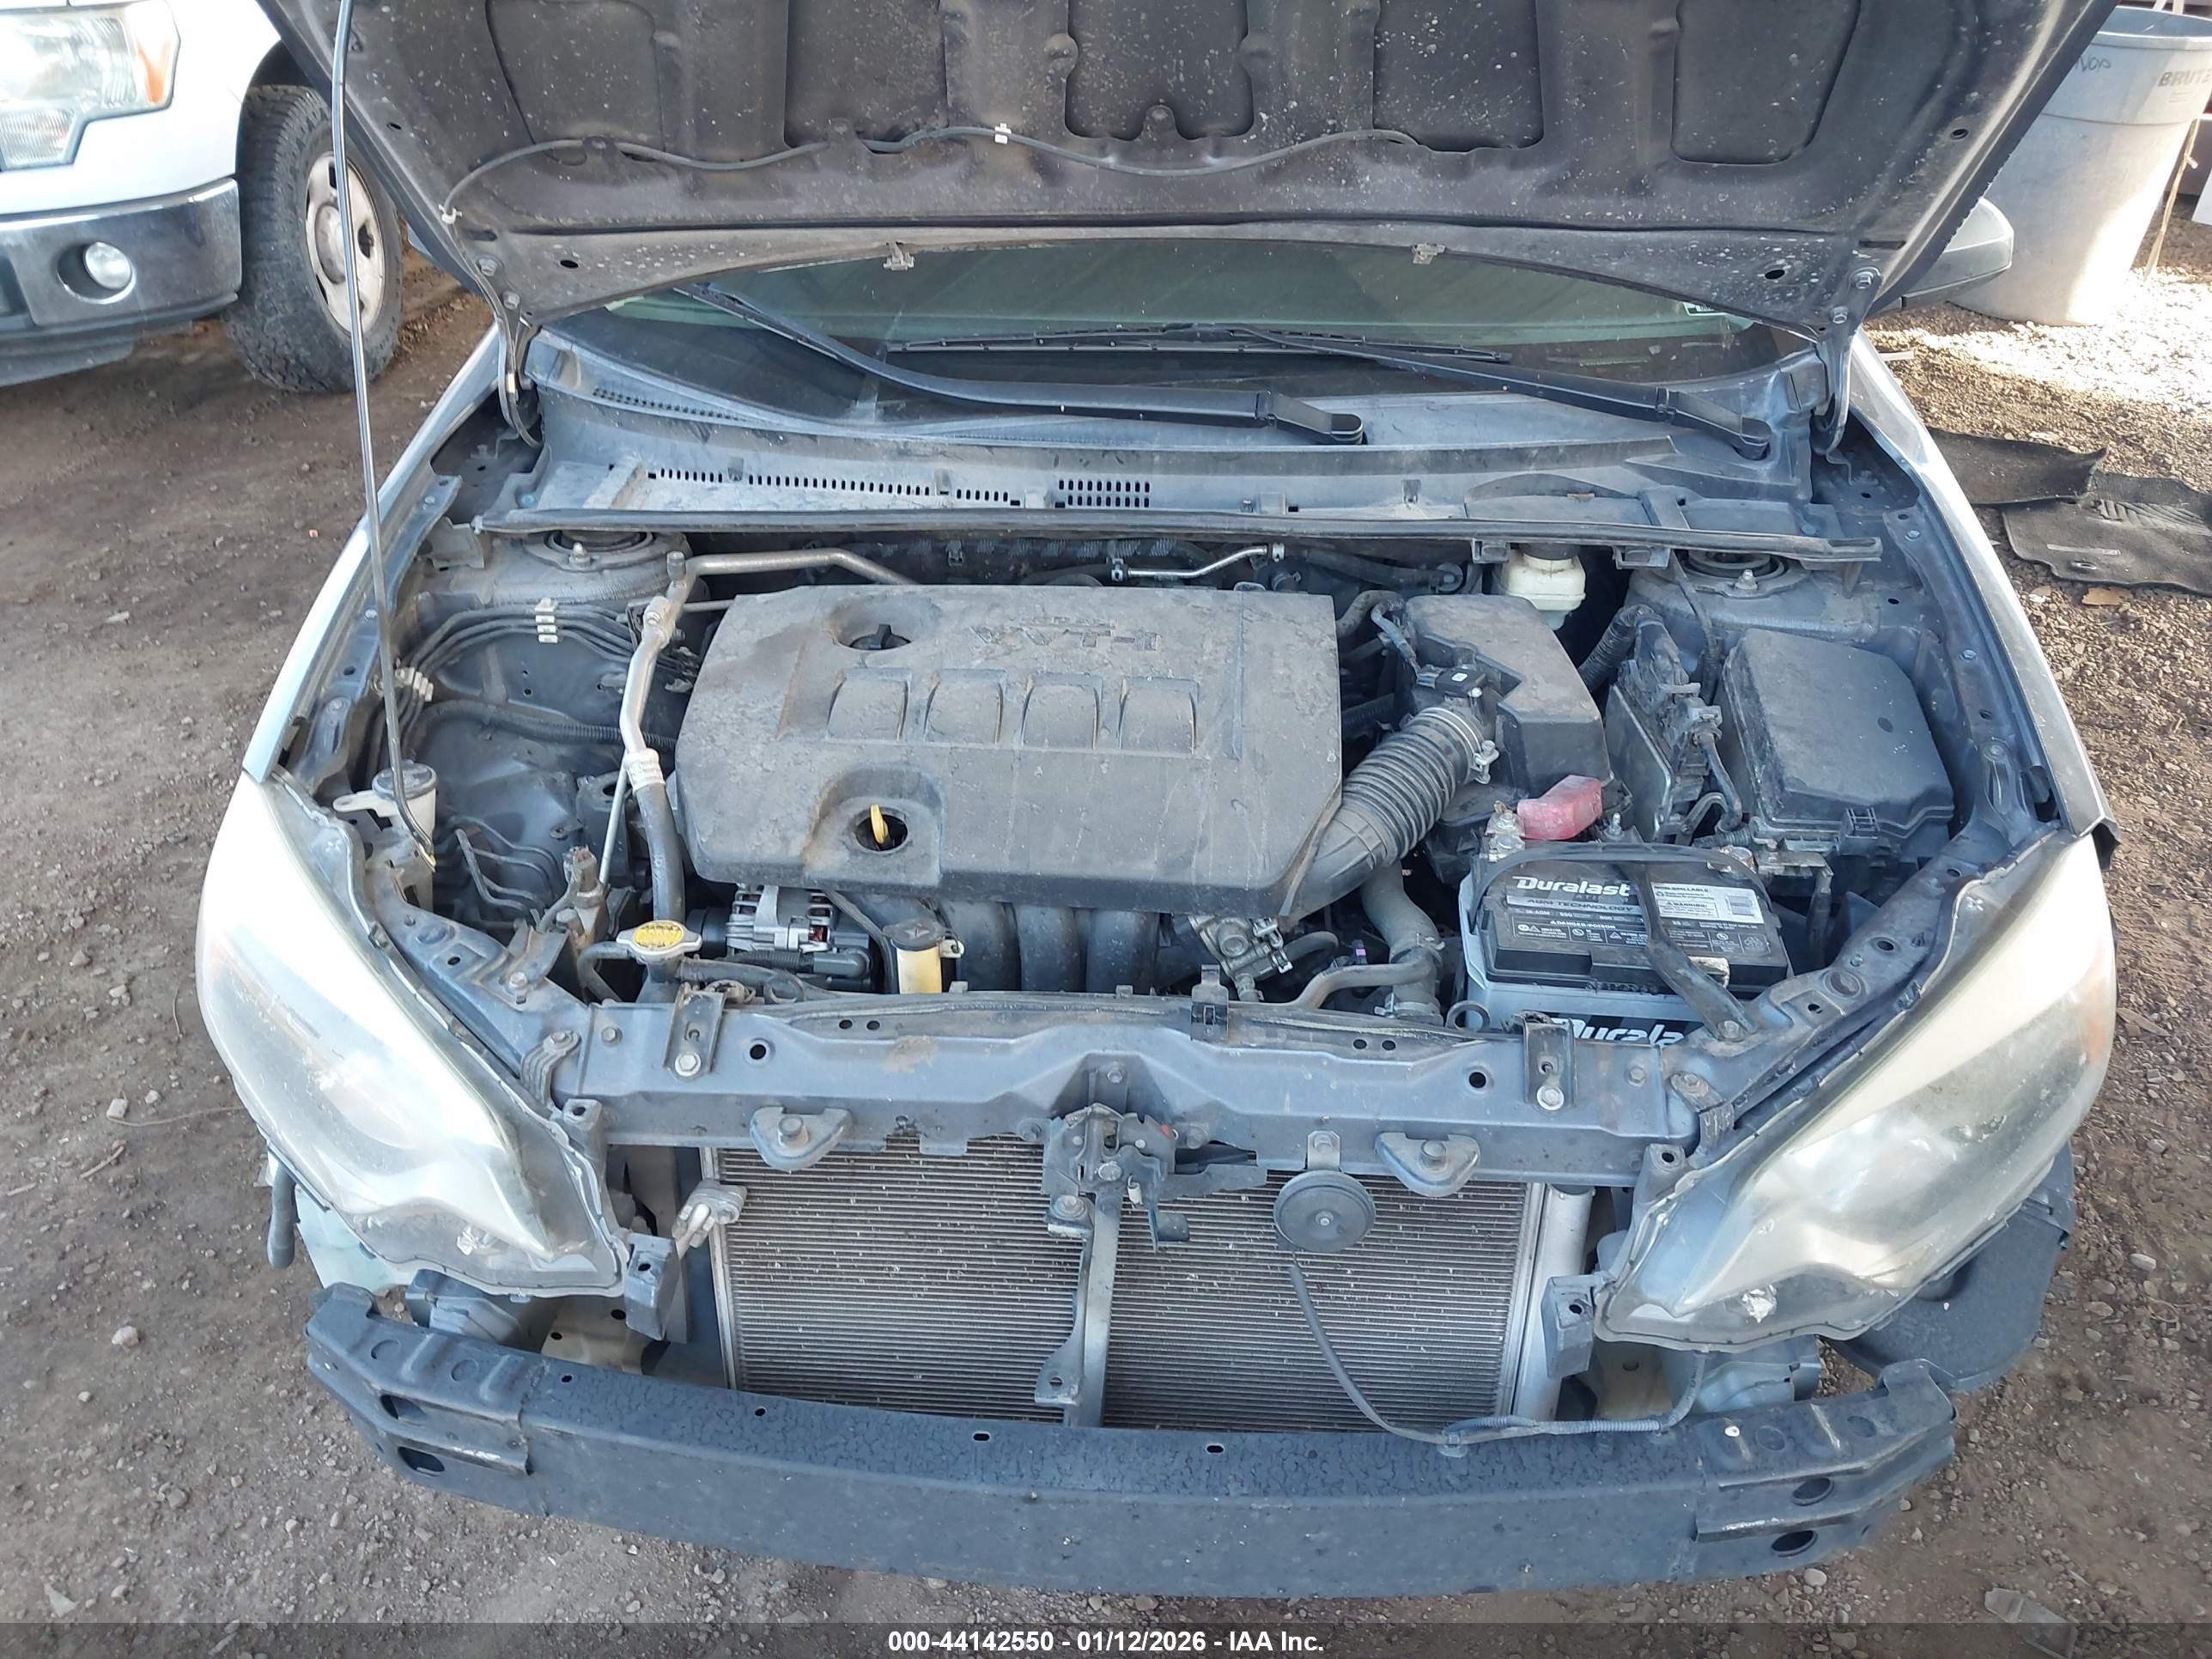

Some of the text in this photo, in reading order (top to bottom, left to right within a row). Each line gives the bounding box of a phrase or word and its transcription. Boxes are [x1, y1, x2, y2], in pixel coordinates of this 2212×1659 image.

[1511, 875, 1631, 896] Duralast
[1558, 901, 1635, 912] TECHNOLOGY
[1550, 1017, 1686, 1048] Durala
